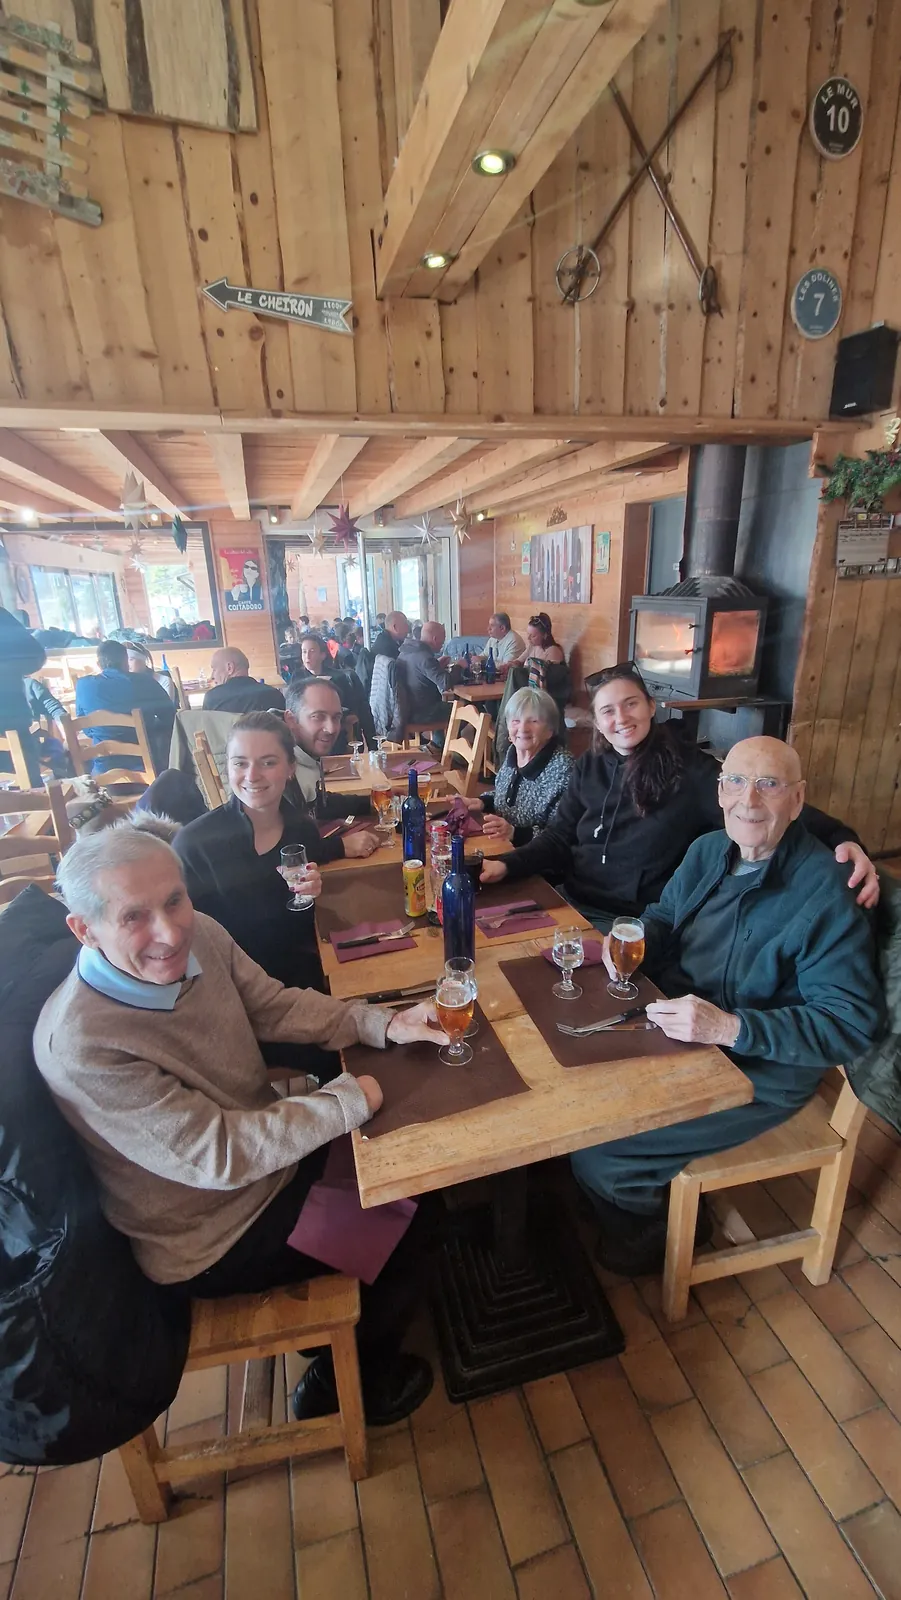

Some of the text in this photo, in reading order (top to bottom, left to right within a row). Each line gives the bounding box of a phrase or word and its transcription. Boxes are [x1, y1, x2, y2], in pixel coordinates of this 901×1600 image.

[821, 83, 859, 109] LE MUR
[826, 104, 850, 134] 10
[798, 280, 811, 302] LES
[813, 292, 825, 316] 7
[237, 291, 253, 304] LE
[258, 294, 314, 318] CHEIRON
